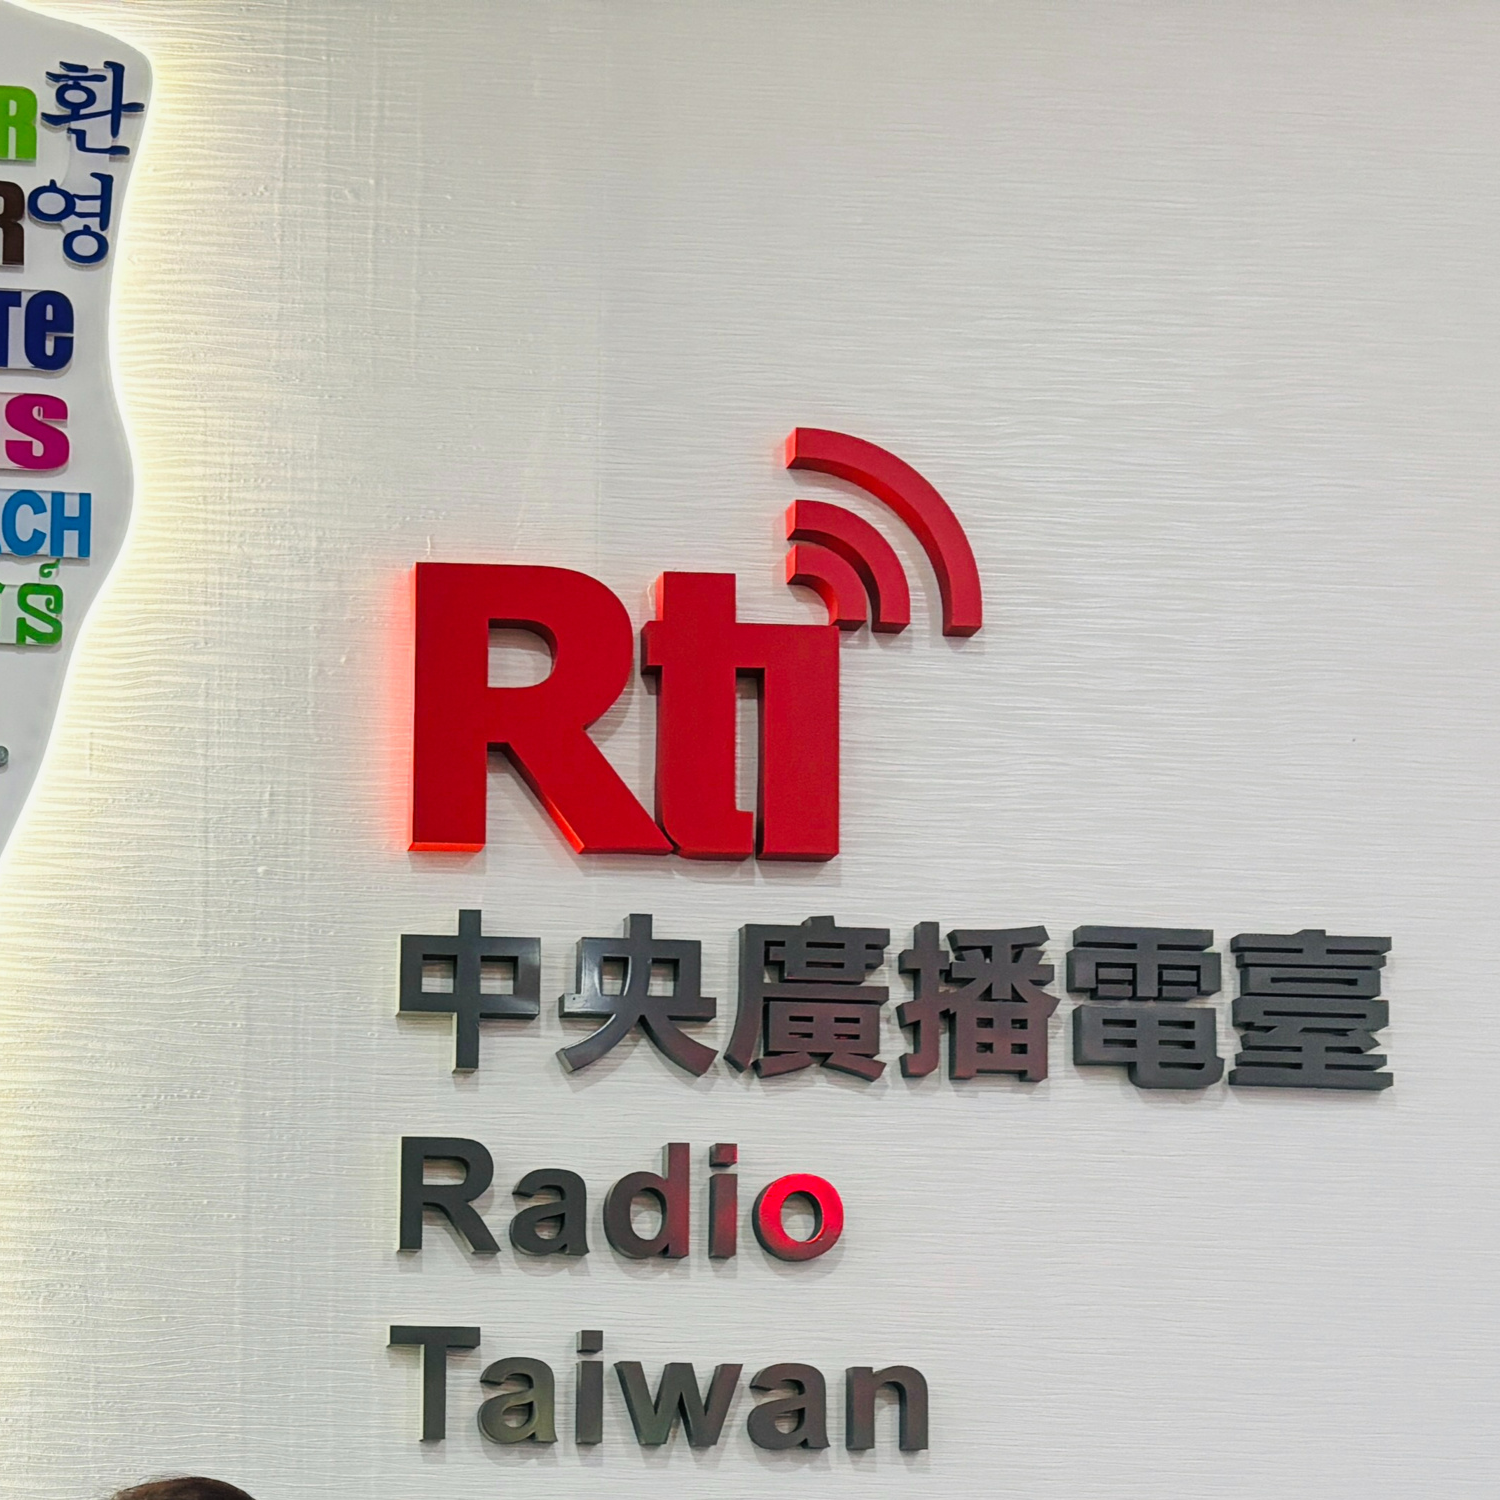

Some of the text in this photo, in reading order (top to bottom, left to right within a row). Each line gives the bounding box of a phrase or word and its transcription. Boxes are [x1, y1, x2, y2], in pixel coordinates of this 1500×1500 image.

[27, 60, 145, 265] 환영
[407, 560, 842, 862] Rti
[398, 909, 1394, 1092] 中央廣播電臺
[397, 1136, 845, 1262] Radio
[387, 1325, 930, 1454] Taiwan
